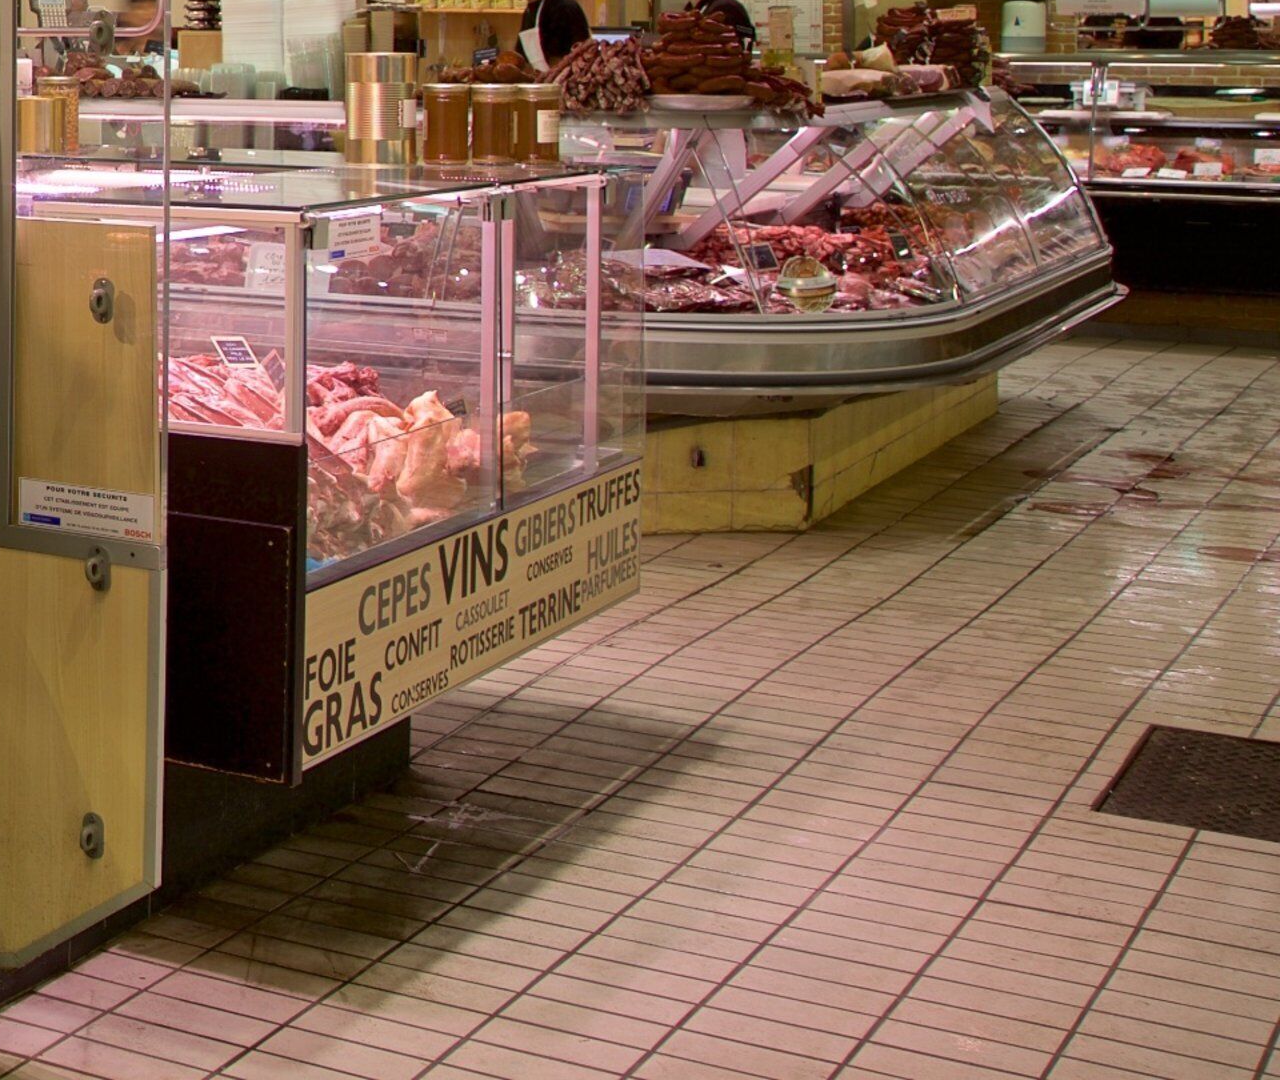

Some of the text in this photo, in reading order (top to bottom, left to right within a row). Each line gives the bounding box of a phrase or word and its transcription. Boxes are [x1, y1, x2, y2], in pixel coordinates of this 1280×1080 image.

[576, 468, 641, 527] TRUFFES
[124, 528, 152, 539] BOSCH
[514, 498, 576, 557] GIBIERS
[587, 518, 638, 575] HUILES
[439, 518, 509, 605] VINS
[527, 545, 573, 582] CONSERVES
[580, 555, 638, 603] PARFUMEES
[358, 562, 432, 635] CEPES
[456, 589, 510, 631] CASSOULET
[518, 579, 581, 639] TERRINE
[304, 638, 356, 700] FOIE
[384, 619, 442, 671] CONFIT
[450, 615, 515, 670] ROTISSERIE
[303, 671, 382, 756] GRAS
[391, 669, 449, 714] CONSERVES
